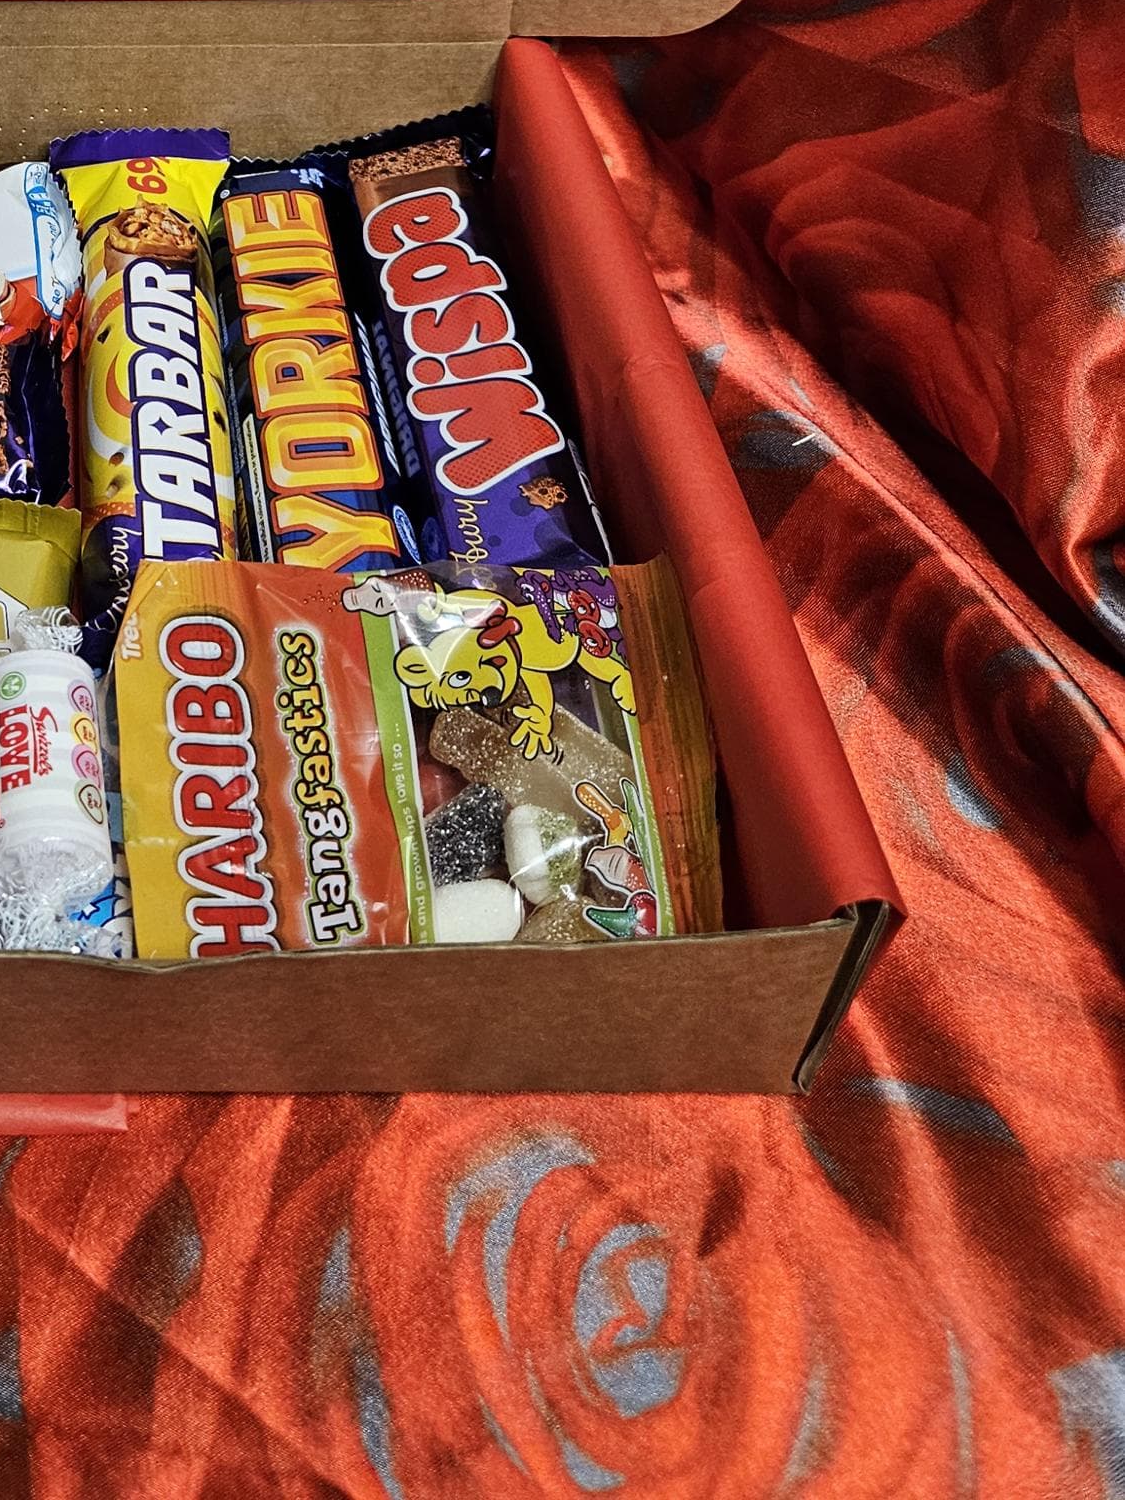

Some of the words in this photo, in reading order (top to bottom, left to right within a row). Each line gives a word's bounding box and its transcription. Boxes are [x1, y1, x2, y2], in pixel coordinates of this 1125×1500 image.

[129, 258, 219, 563] TARBAR
[222, 189, 401, 571] YORKIE
[365, 188, 563, 494] Wispa
[158, 614, 275, 957] HARIBO
[276, 629, 365, 947] Tangfastics
